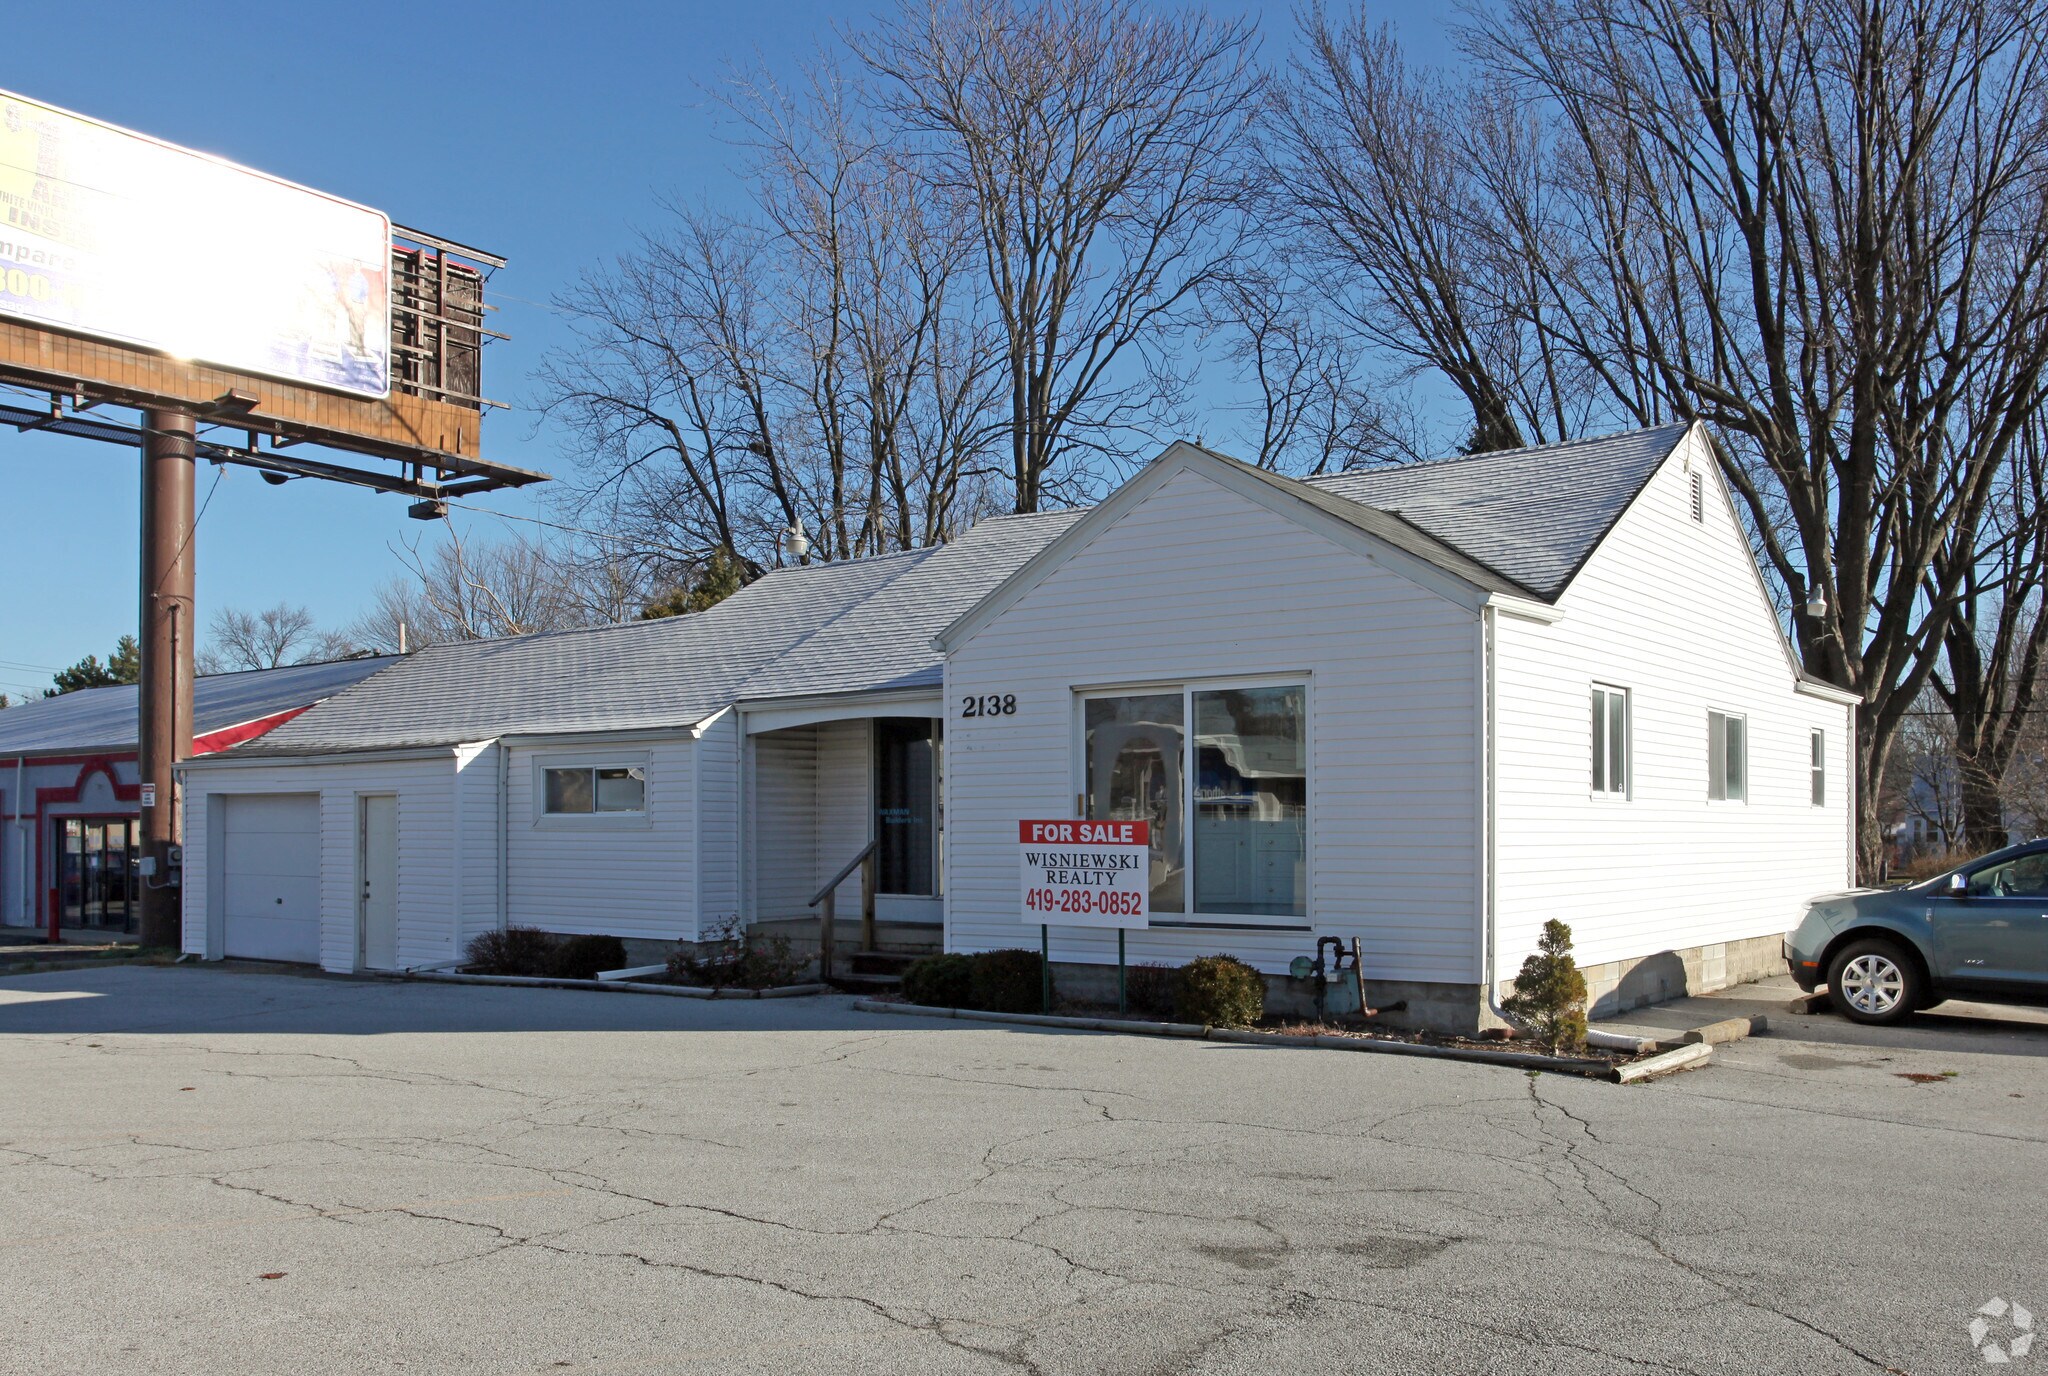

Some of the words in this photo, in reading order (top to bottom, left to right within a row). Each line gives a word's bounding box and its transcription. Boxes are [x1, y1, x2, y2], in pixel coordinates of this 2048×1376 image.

[962, 694, 1017, 718] 2138
[1032, 823, 1074, 842] FOR
[1079, 824, 1134, 843] SALE
[1025, 852, 1140, 869] WISNIEWSKI
[1046, 870, 1118, 886] REALTY
[1026, 888, 1142, 915] 419-283-0852
